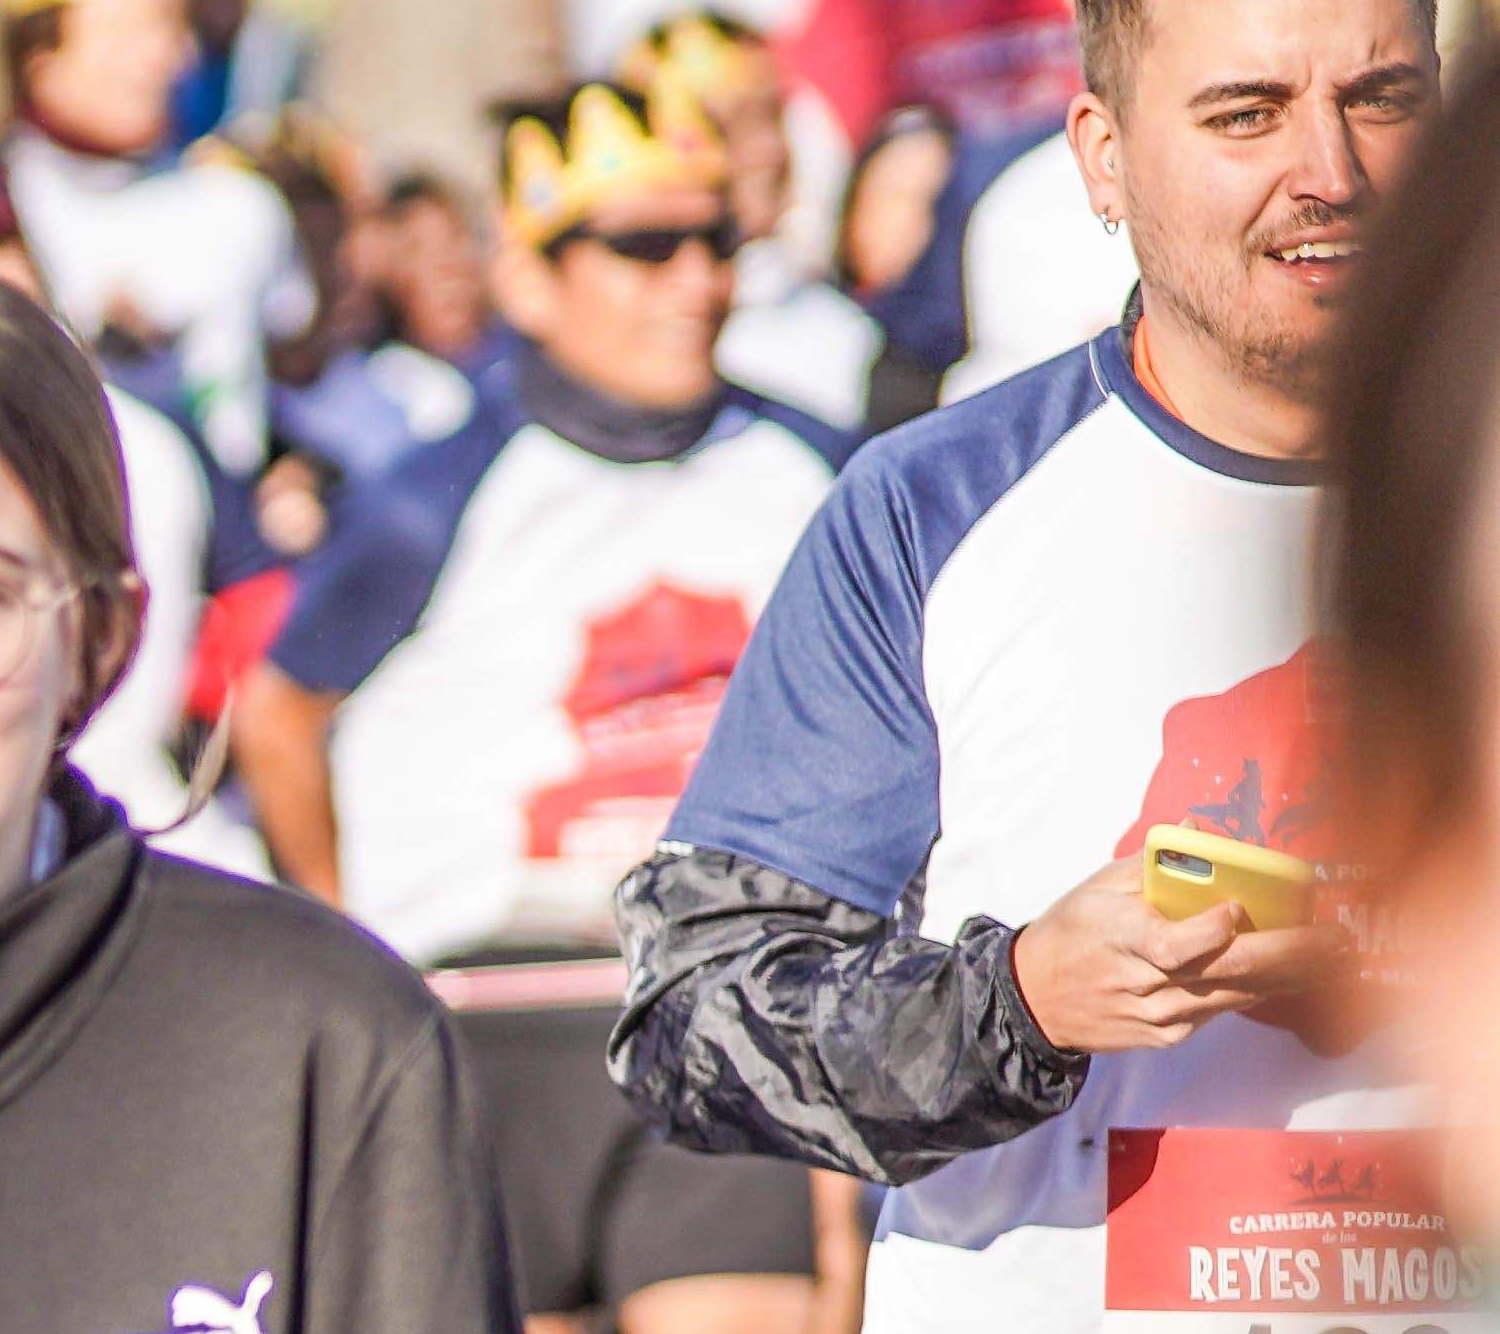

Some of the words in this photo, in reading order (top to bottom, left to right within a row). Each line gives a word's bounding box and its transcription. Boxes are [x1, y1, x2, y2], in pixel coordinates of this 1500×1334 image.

[1230, 1211, 1337, 1235] CARRERA
[1343, 1210, 1446, 1231] POPULAR
[1189, 1245, 1321, 1303] REYES
[1342, 1246, 1484, 1306] MAGOS
